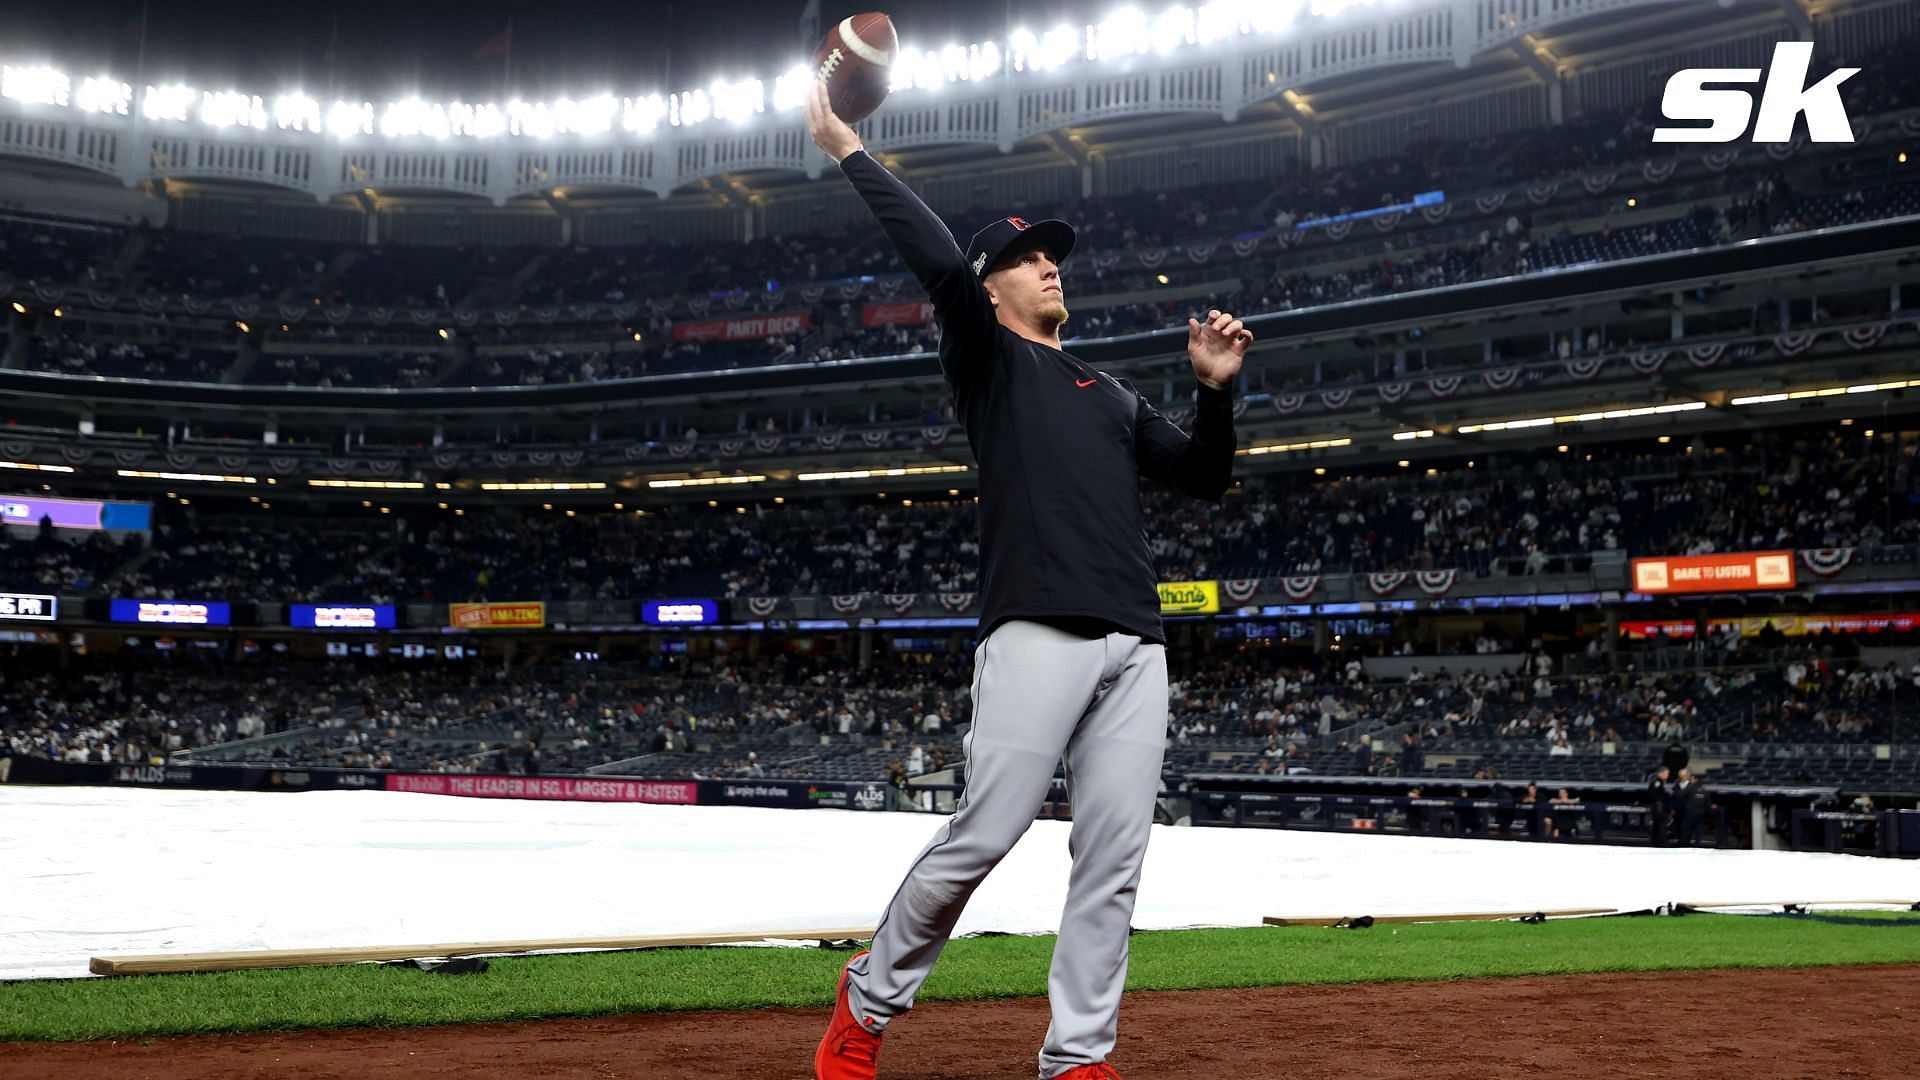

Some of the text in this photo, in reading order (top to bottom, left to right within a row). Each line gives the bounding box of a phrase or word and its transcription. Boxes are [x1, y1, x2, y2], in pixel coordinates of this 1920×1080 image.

[727, 319, 765, 337] PARTY
[768, 315, 801, 334] DECK
[1673, 564, 1751, 581] DARE TO LISTEN
[132, 767, 164, 783] ALDS
[450, 778, 474, 792] THE
[476, 779, 524, 794] LEADER
[526, 781, 540, 794] IN
[565, 782, 625, 797] LARGEST
[626, 784, 636, 797] &
[854, 790, 885, 801] ALDS
